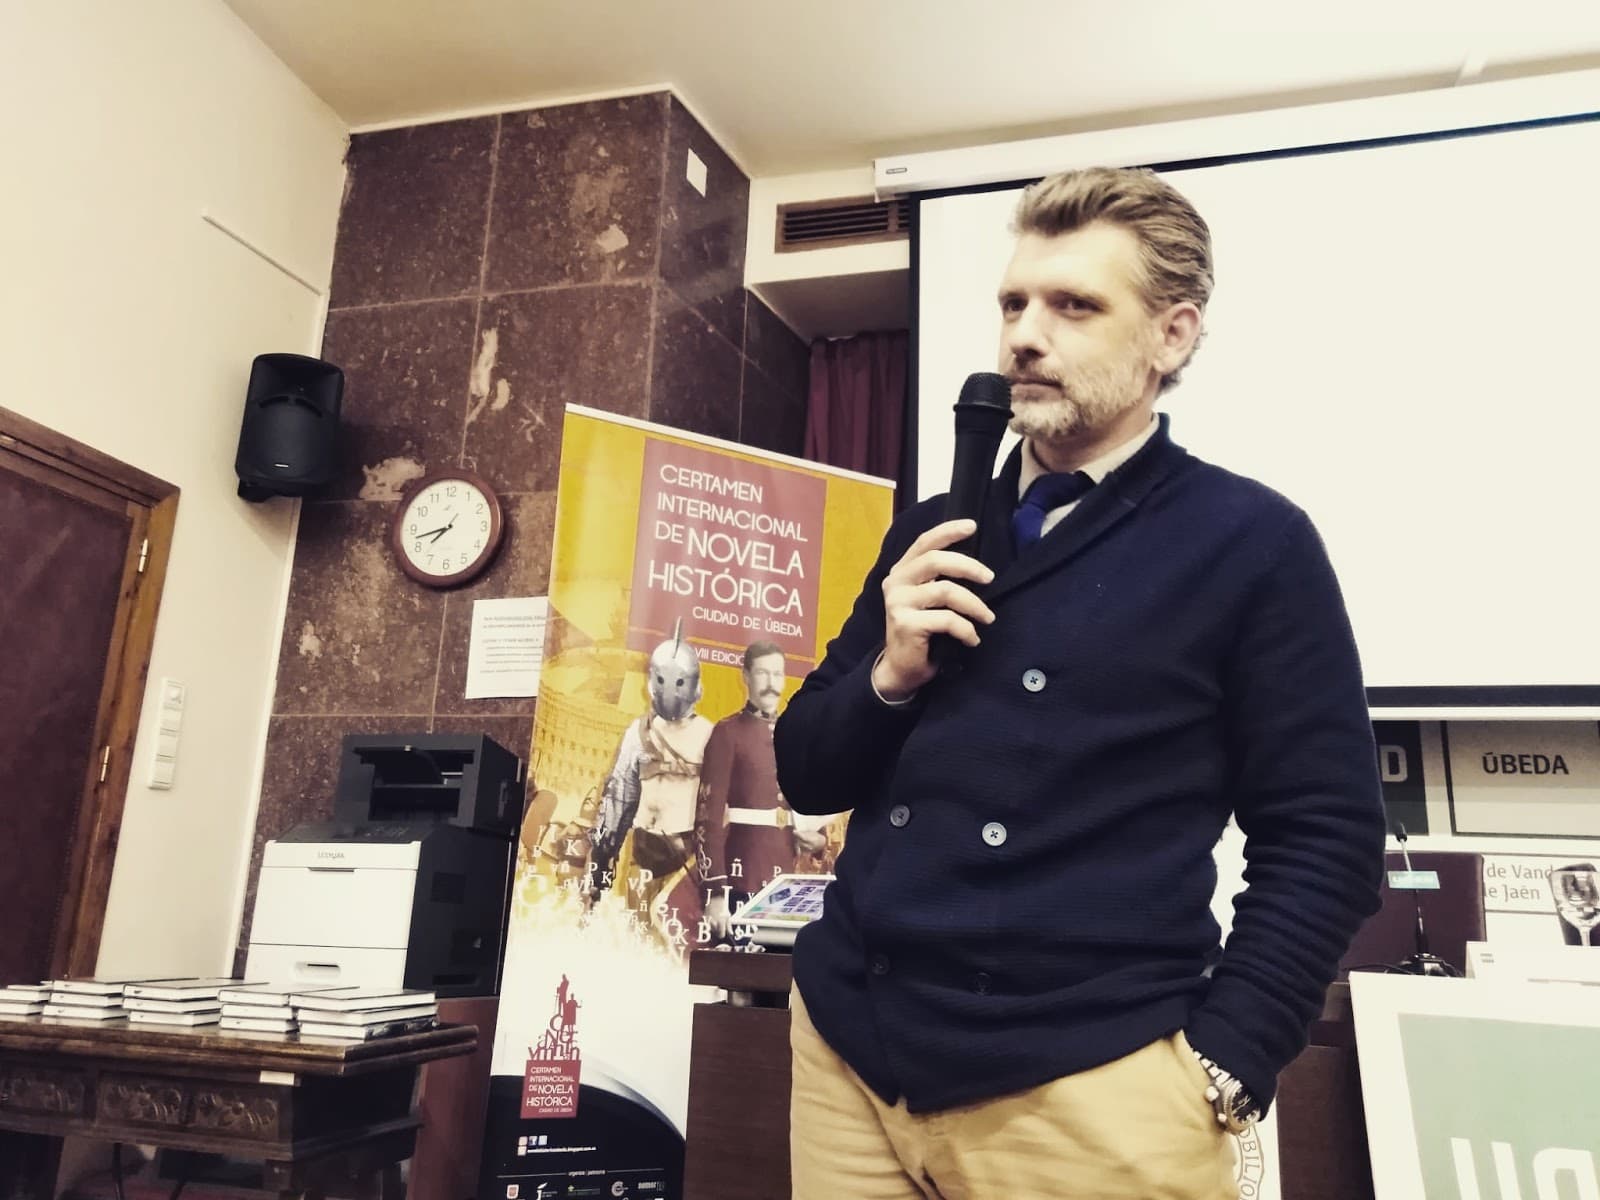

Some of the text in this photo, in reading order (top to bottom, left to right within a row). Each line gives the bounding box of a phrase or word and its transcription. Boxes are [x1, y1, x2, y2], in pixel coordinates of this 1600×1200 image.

[660, 464, 763, 504] CERTAMEN
[446, 486, 457, 497] 12
[466, 491, 471, 502] 1
[430, 493, 440, 503] 11
[417, 506, 428, 517] 10
[475, 503, 484, 514] 2
[657, 492, 808, 542] INTERNACIONAL
[410, 524, 417, 535] 9
[480, 520, 488, 532] 3
[414, 541, 422, 553] 8
[474, 539, 481, 549] 4
[655, 520, 804, 579] DE NOVELA
[427, 554, 435, 565] 7
[442, 558, 450, 570] 6
[460, 552, 468, 564] 5
[648, 559, 803, 617] HISTÓRICA
[692, 606, 803, 637] CIUDAD DE ÚBEDA
[695, 647, 709, 660] VIII
[1482, 752, 1570, 775] ÚBEDA
[565, 839, 581, 856] K
[731, 858, 744, 877] ñ
[1486, 862, 1506, 878] de
[639, 869, 654, 883] P
[1484, 882, 1540, 903] e Jaén
[697, 921, 711, 943] B
[530, 1066, 562, 1074] CERTAMEN
[529, 1075, 575, 1083] INTERNACIONAL
[528, 1084, 574, 1094] DE NOVELA
[526, 1094, 573, 1107] HISTÓRICA
